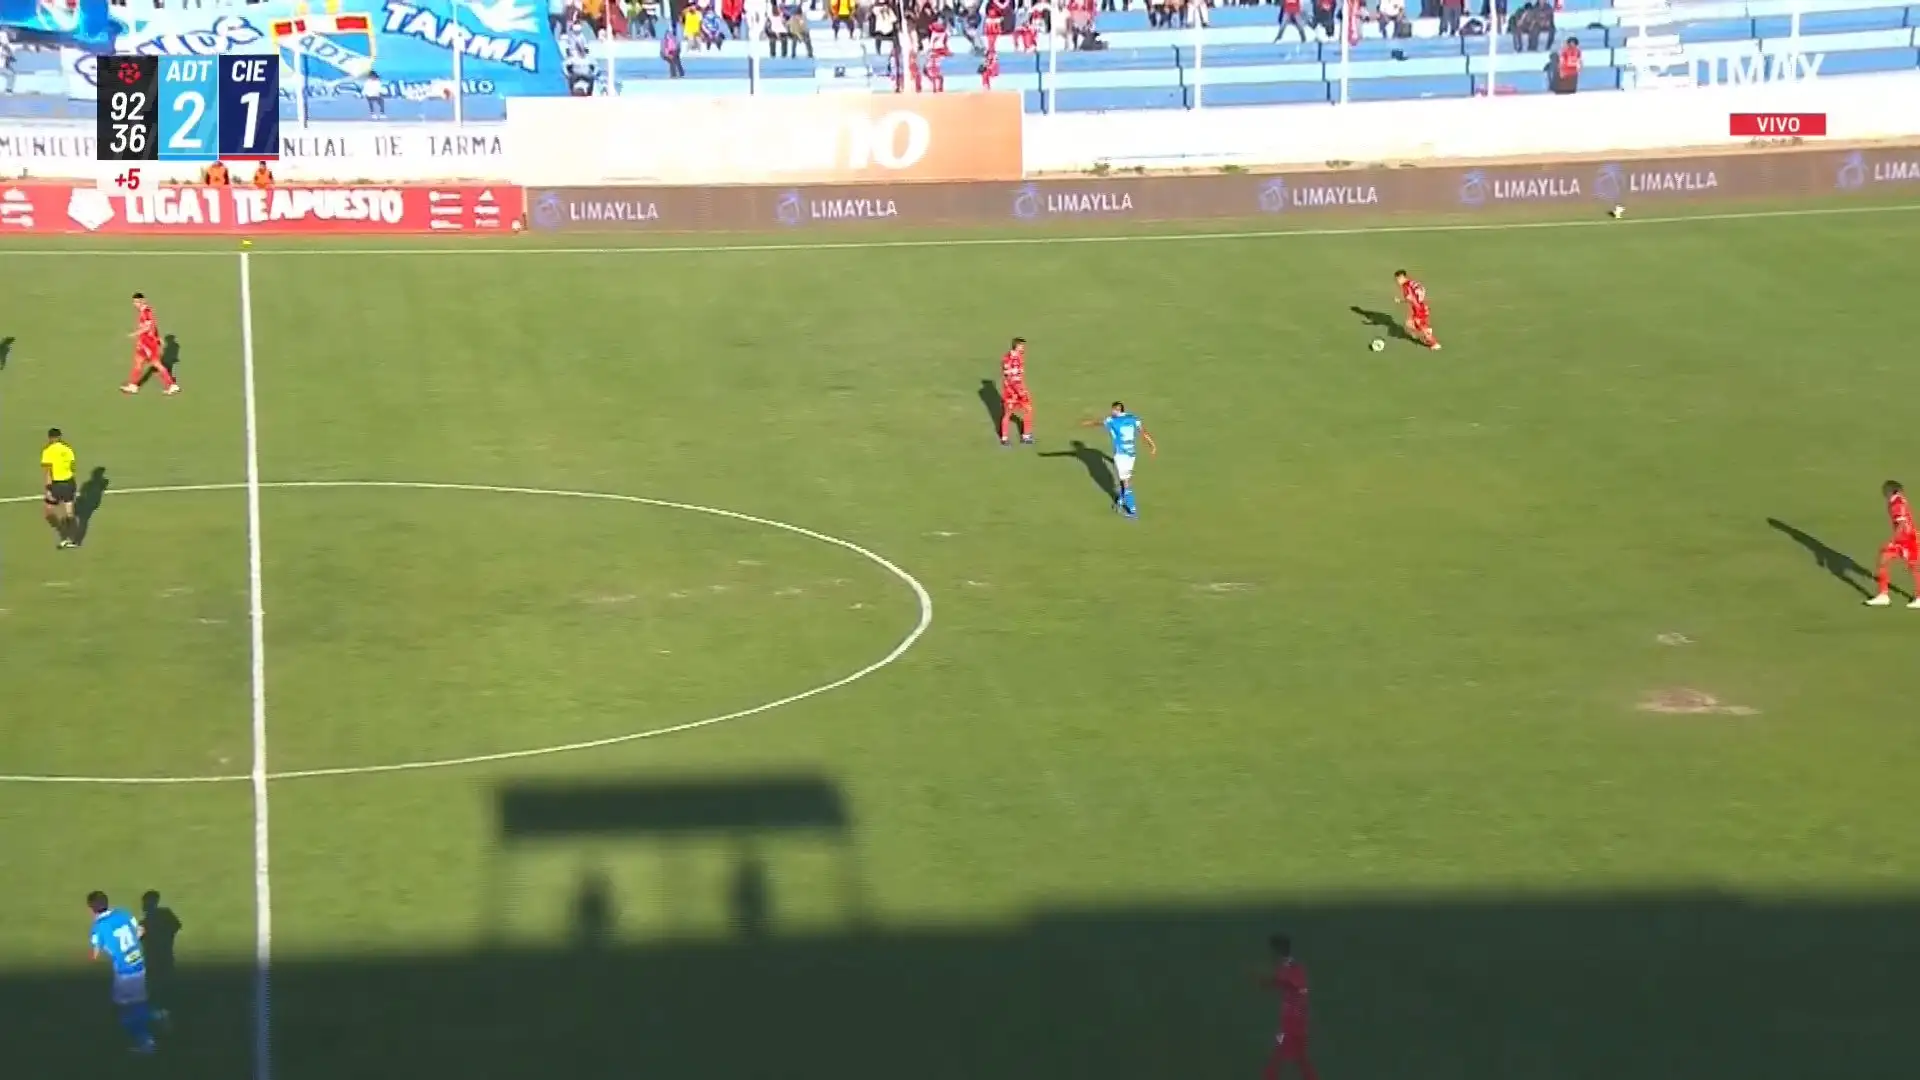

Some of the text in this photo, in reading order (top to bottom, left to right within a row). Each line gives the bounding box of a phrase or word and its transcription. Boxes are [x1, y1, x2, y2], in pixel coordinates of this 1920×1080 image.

[382, 0, 539, 73] TARMA
[428, 135, 503, 156] TARMA
[1494, 178, 1582, 199] LIMAYLLA
[1629, 169, 1719, 192] LIMAYLLA
[1047, 193, 1134, 212] LIMAYLLA
[1292, 185, 1379, 206] LIMAYLLA
[569, 202, 660, 221] LIMAYLLA
[810, 199, 898, 218] LIMAYLLA
